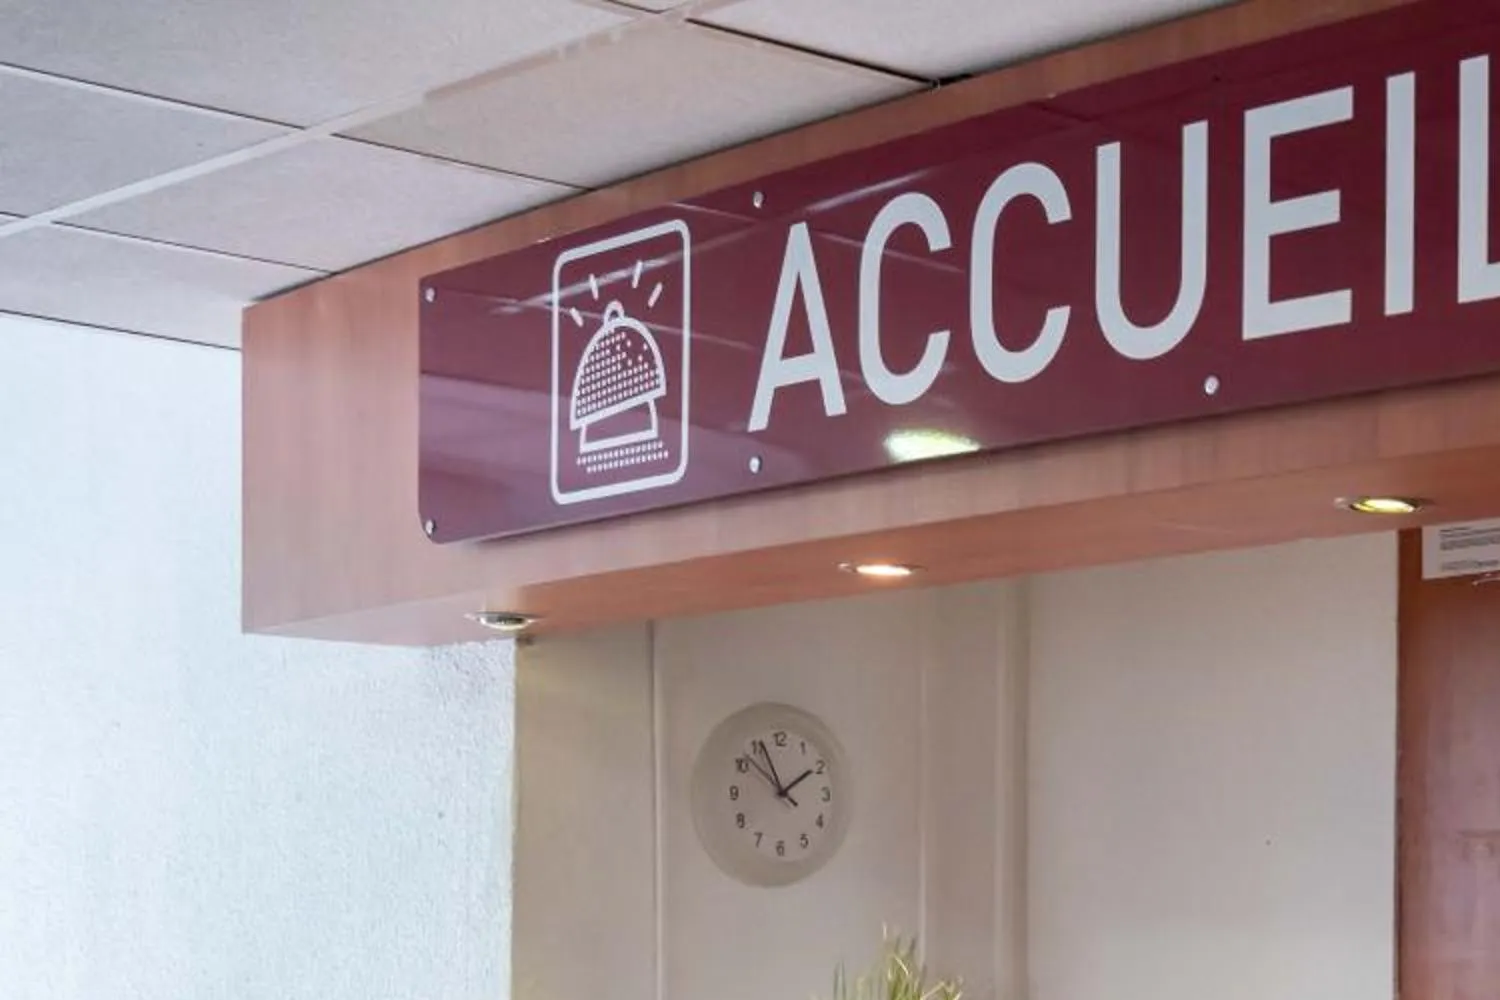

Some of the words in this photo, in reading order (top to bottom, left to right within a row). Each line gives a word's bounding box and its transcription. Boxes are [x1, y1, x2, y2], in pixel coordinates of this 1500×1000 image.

[773, 731, 787, 746] 12
[735, 758, 750, 773] 10
[815, 760, 826, 774] 2
[729, 785, 739, 800] 9
[821, 786, 831, 802] 3
[736, 812, 745, 828] 8
[815, 813, 824, 829] 4
[753, 832, 763, 848] 7
[776, 840, 785, 856] 6
[800, 833, 809, 849] 5
